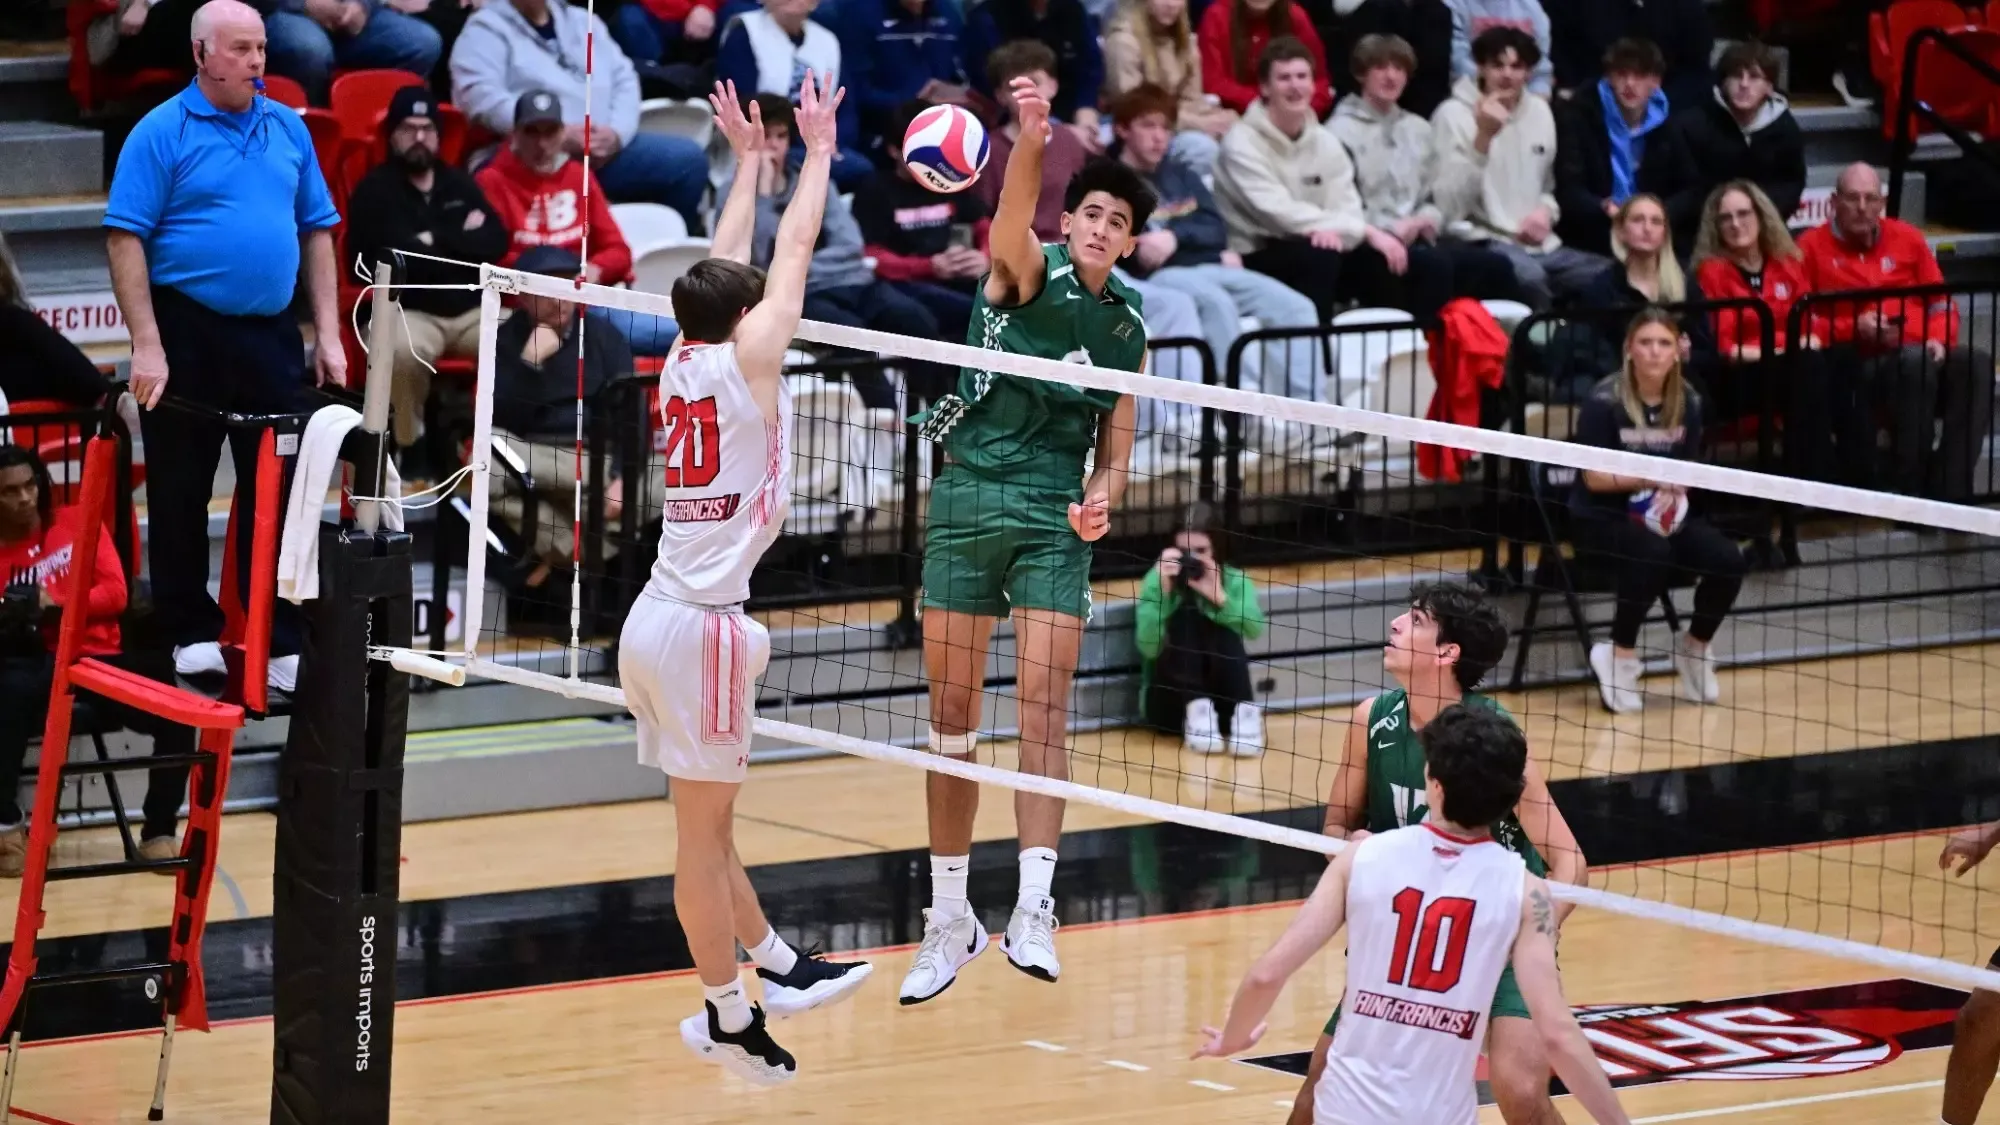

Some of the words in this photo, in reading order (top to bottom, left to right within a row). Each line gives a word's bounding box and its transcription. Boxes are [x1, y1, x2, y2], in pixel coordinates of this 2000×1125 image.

[665, 395, 721, 488] 20
[359, 915, 376, 985] sports
[1387, 886, 1477, 994] 10
[1389, 999, 1469, 1034] FRANCIS
